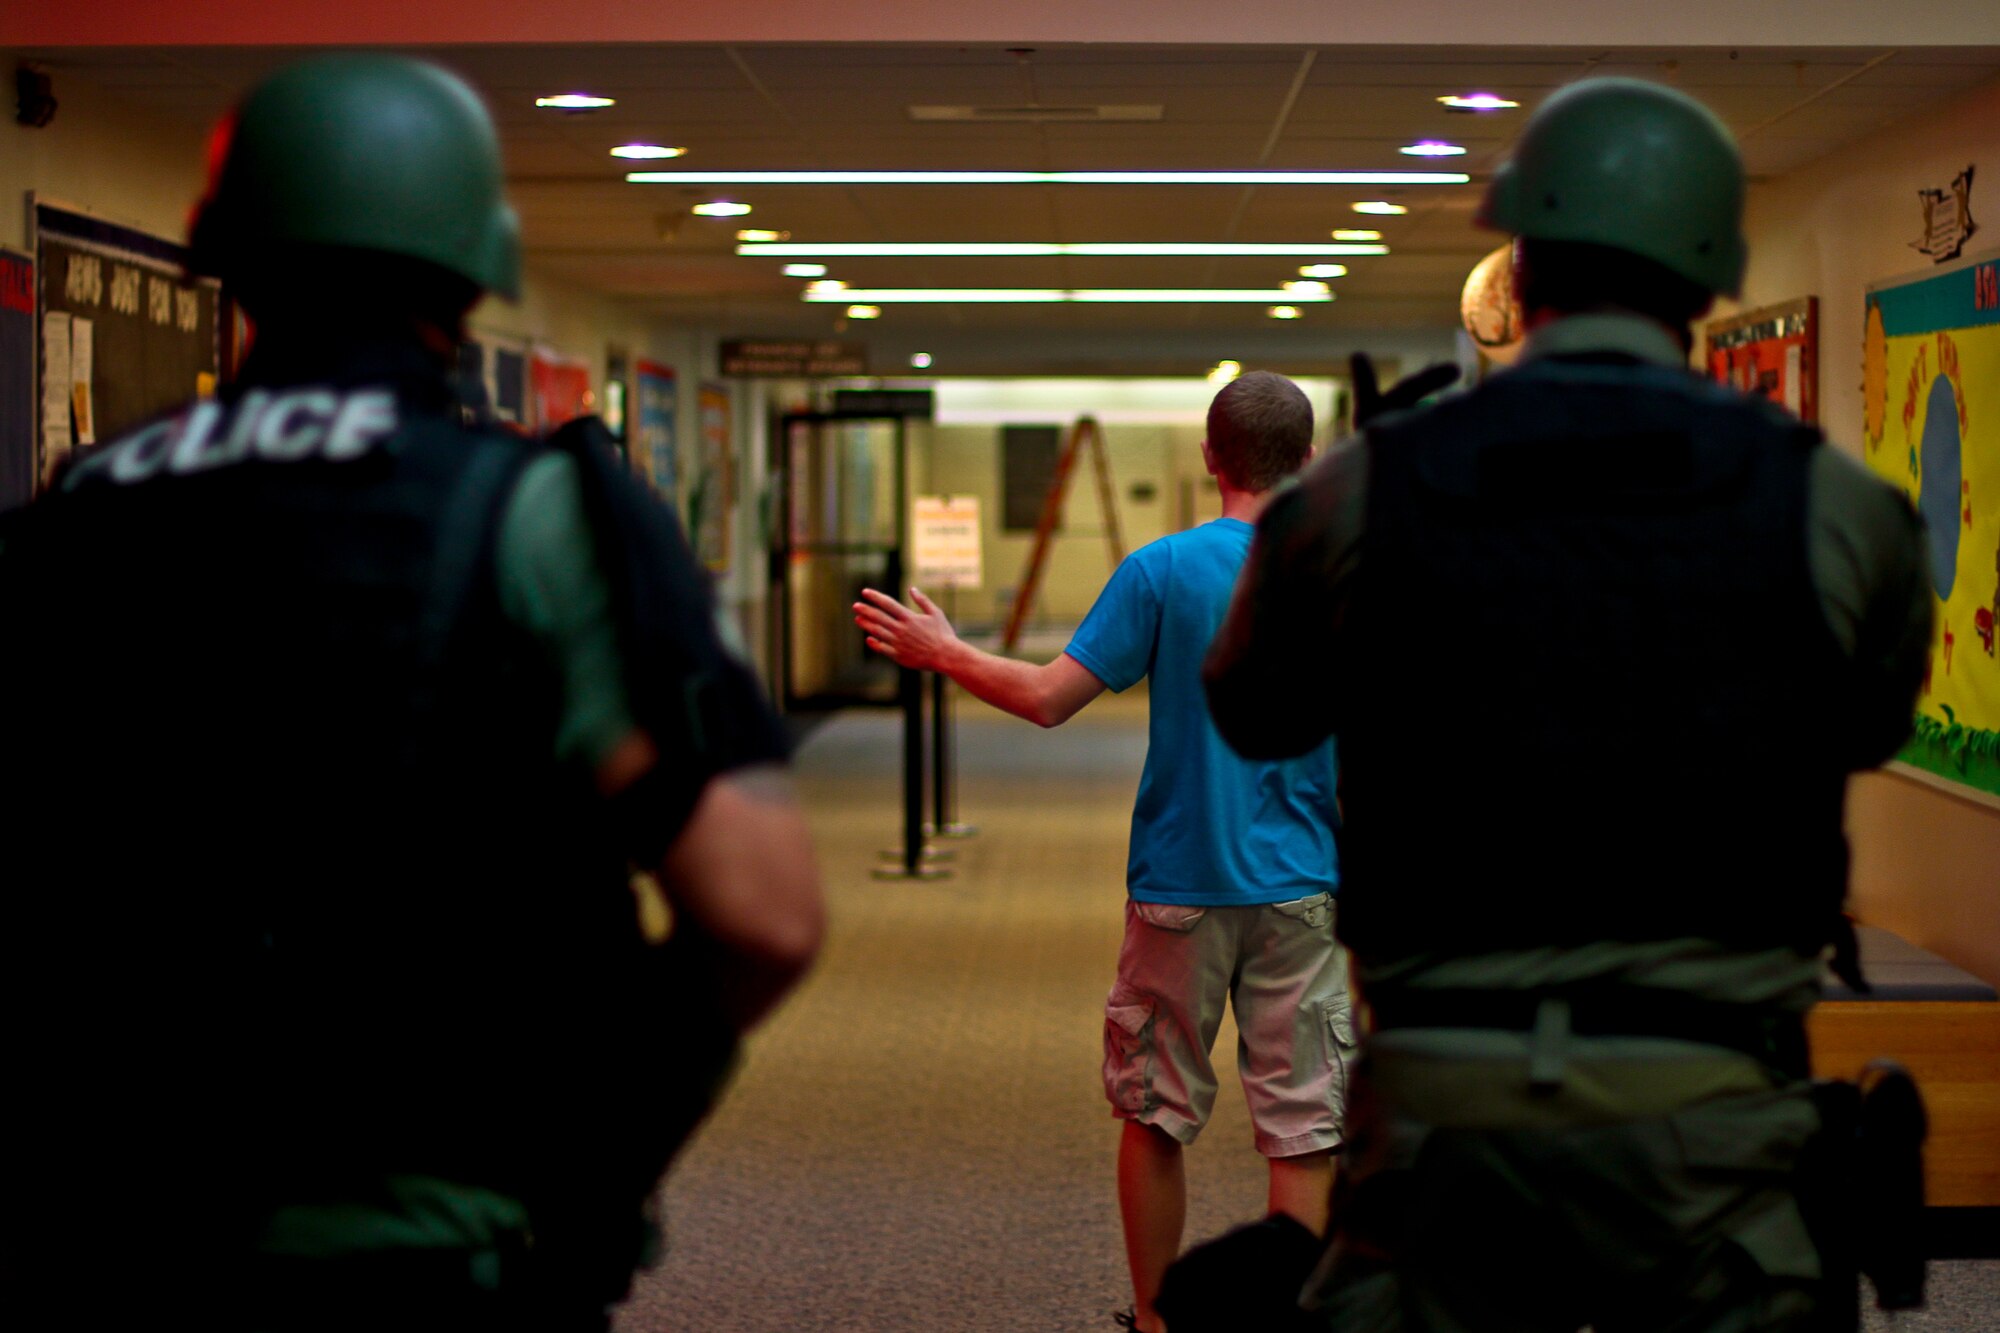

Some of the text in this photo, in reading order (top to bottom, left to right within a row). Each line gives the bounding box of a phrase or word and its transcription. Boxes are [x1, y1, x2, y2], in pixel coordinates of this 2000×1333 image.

[65, 253, 103, 306] NEWS
[110, 263, 141, 316] JUST
[148, 275, 172, 326] FOR
